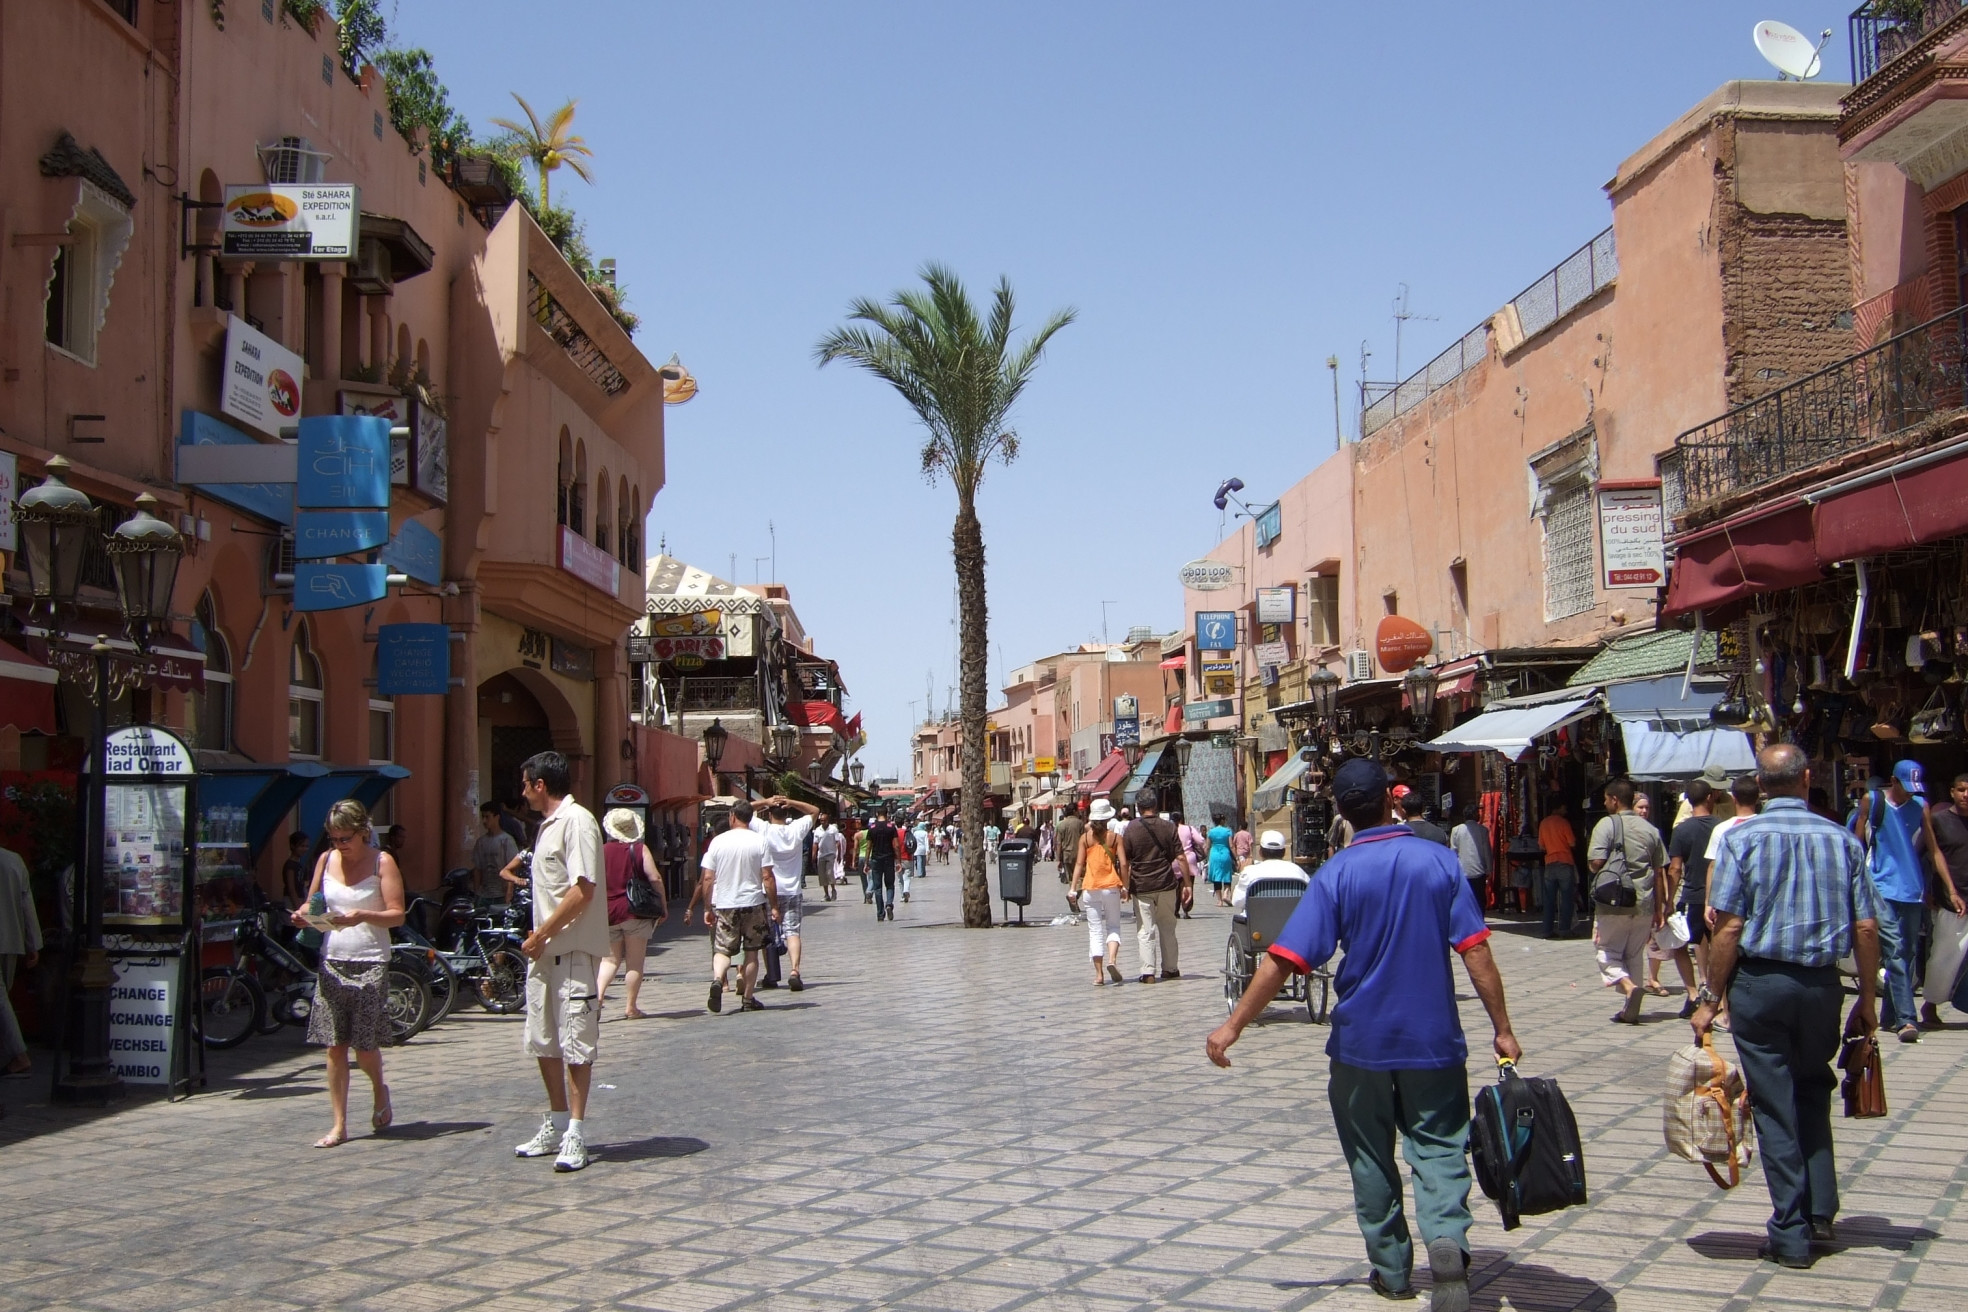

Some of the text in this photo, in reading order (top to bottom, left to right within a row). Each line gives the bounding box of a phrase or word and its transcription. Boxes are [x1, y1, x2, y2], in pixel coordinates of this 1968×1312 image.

[303, 190, 351, 199] Sté SAHARA
[303, 202, 351, 211] EXPEDITION
[326, 246, 347, 254] Etage
[242, 340, 261, 361] SAHARA
[234, 361, 264, 387] EXPEDITION
[1603, 511, 1660, 524] pressing
[305, 528, 373, 540] CHANGE
[1610, 523, 1657, 535] du sud
[1183, 567, 1231, 576] GOOD LOOK
[393, 648, 433, 657] CHANGE
[654, 638, 724, 659] BARI'S
[1404, 643, 1428, 651] Telecom
[394, 658, 432, 667] CAMBIO
[675, 655, 703, 667] Pizza
[160, 659, 192, 680] سناك
[390, 668, 435, 677] WECHSEL
[387, 678, 438, 688] EXCHANGE
[106, 742, 176, 756] Restaurant
[107, 757, 182, 772] iad Omar
[110, 987, 165, 1001] CHANGE
[110, 1012, 173, 1027] XCHANGE
[109, 1063, 160, 1078] CAMBIO
